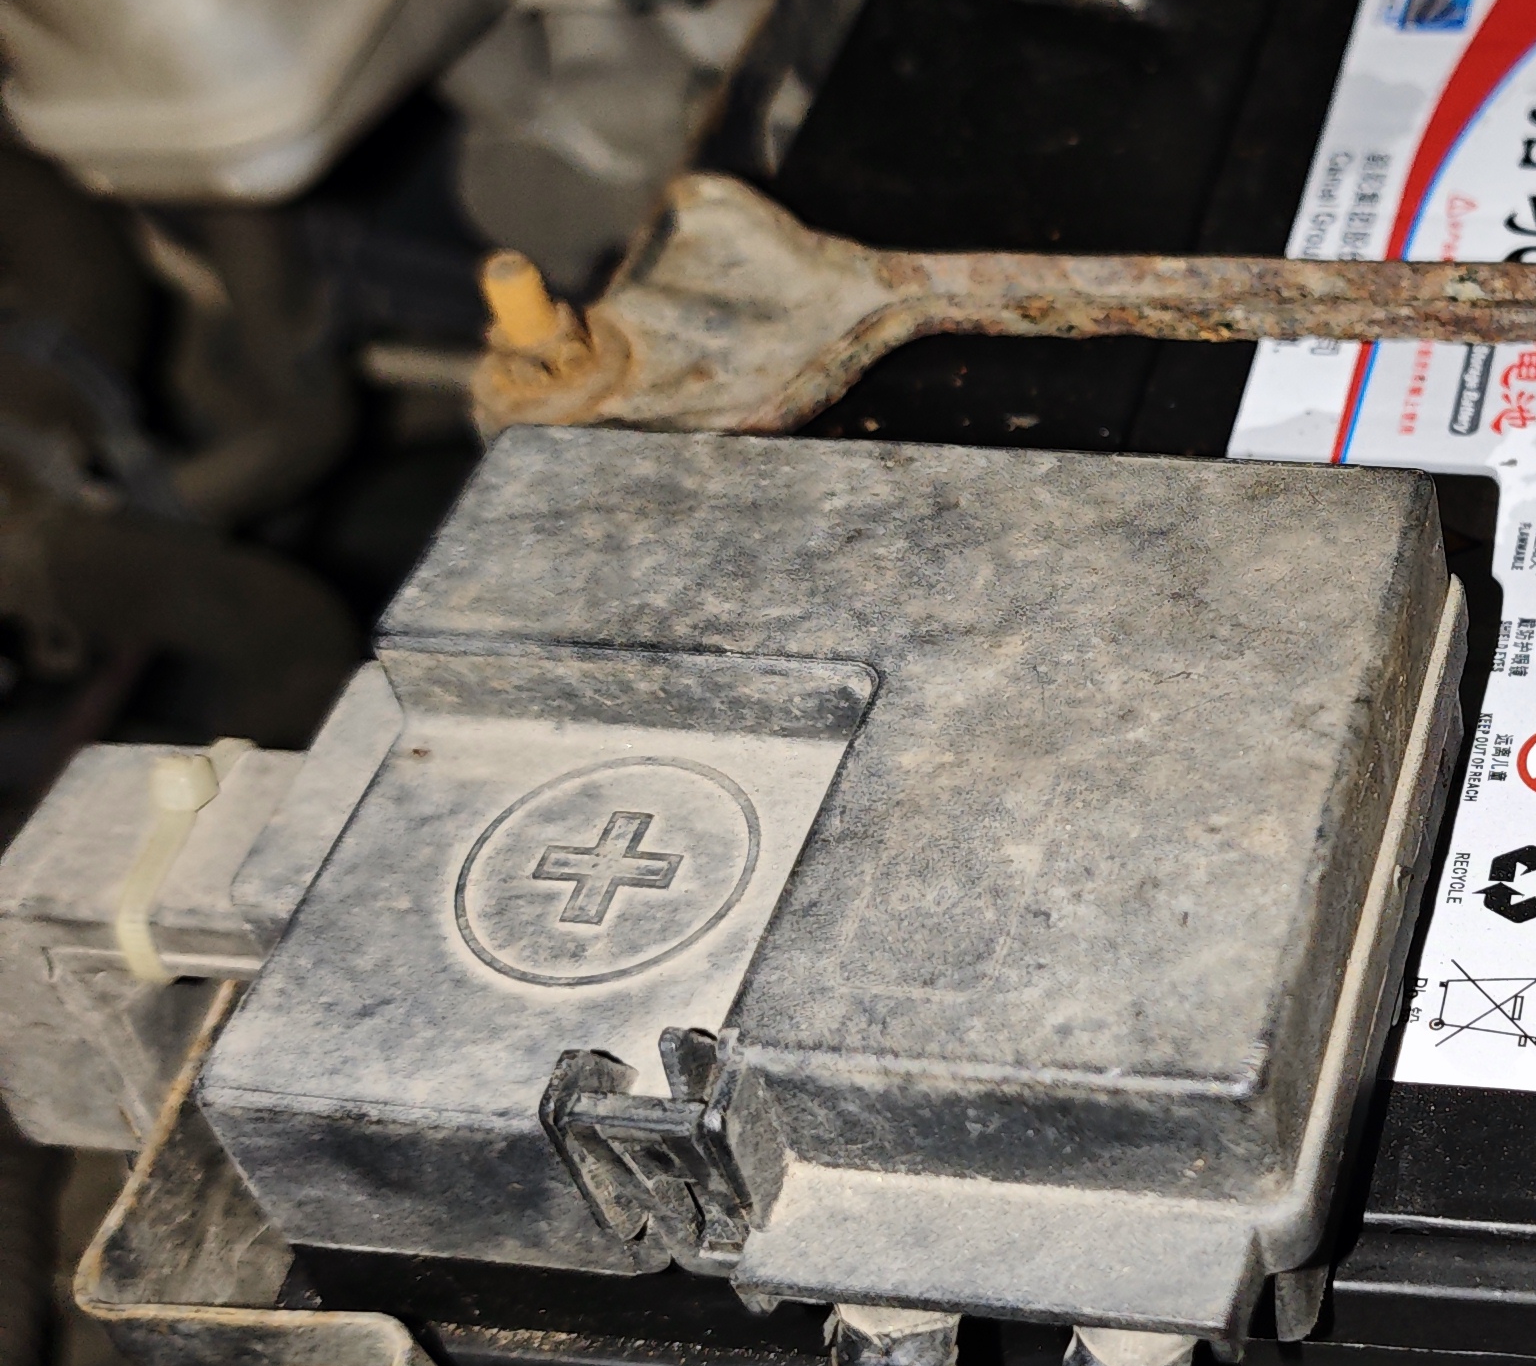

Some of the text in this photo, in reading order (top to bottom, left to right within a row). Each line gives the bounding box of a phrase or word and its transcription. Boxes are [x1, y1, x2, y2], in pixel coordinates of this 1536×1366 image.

[1451, 390, 1479, 434] Battery
[1510, 522, 1532, 571] FLAMMABLE
[1507, 617, 1536, 678] 戴防护眼镜
[1463, 713, 1492, 802] KEEP OUT OF REACH
[1486, 734, 1512, 782] 远离儿童
[1445, 852, 1470, 906] RECYCLE
